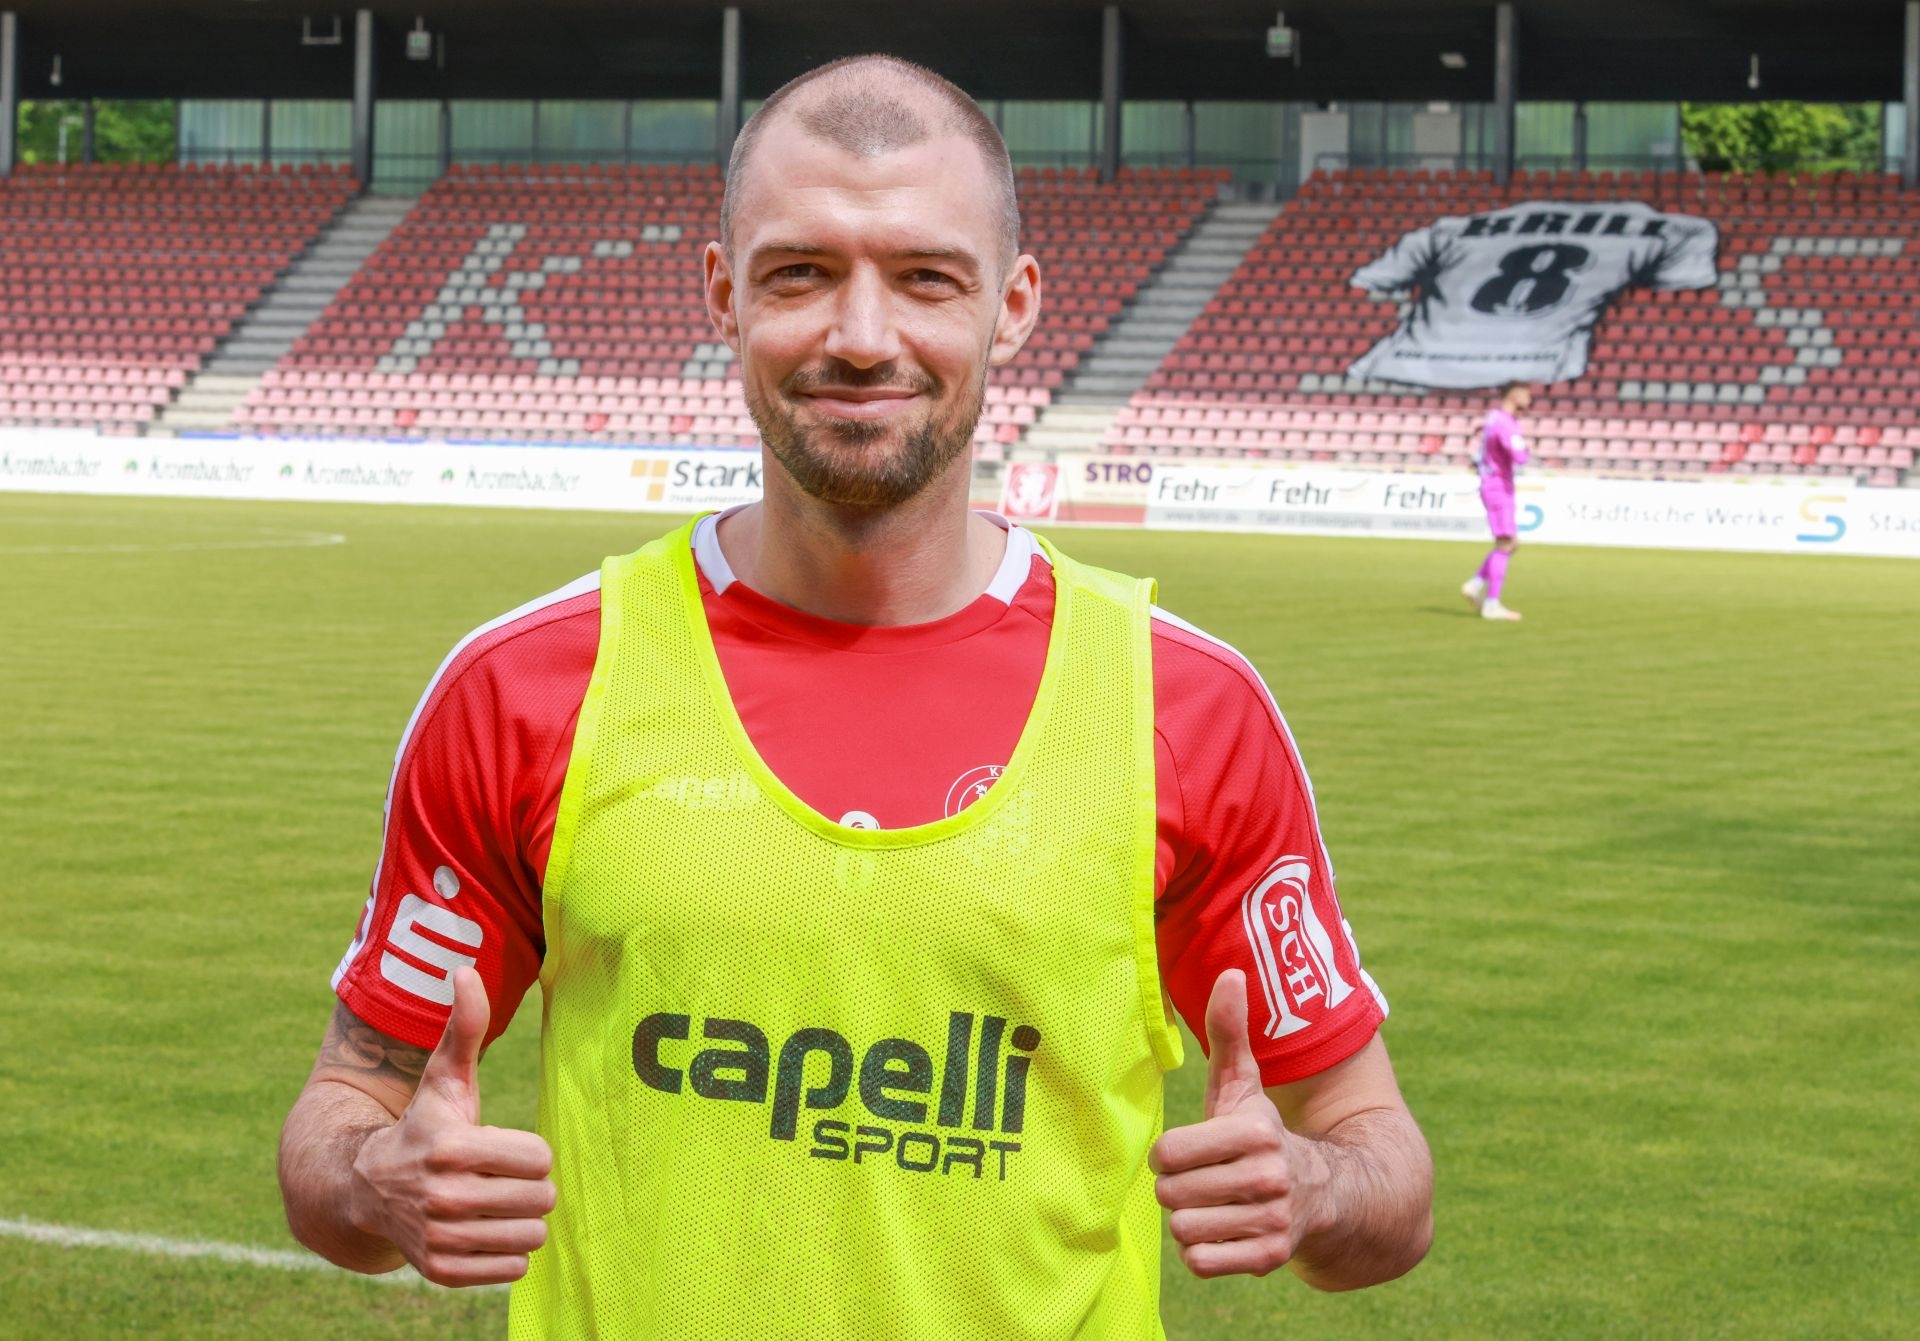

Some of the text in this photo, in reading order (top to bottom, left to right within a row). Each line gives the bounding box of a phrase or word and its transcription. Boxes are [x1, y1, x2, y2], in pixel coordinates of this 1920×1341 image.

[1471, 242, 1590, 315] 8
[1158, 476, 1219, 502] Fehr
[1269, 479, 1331, 505] Fehr
[1384, 483, 1447, 509] Fehr
[1706, 506, 1784, 528] Werke
[631, 1011, 1042, 1142] capelli
[810, 1119, 1022, 1182] SPORT
